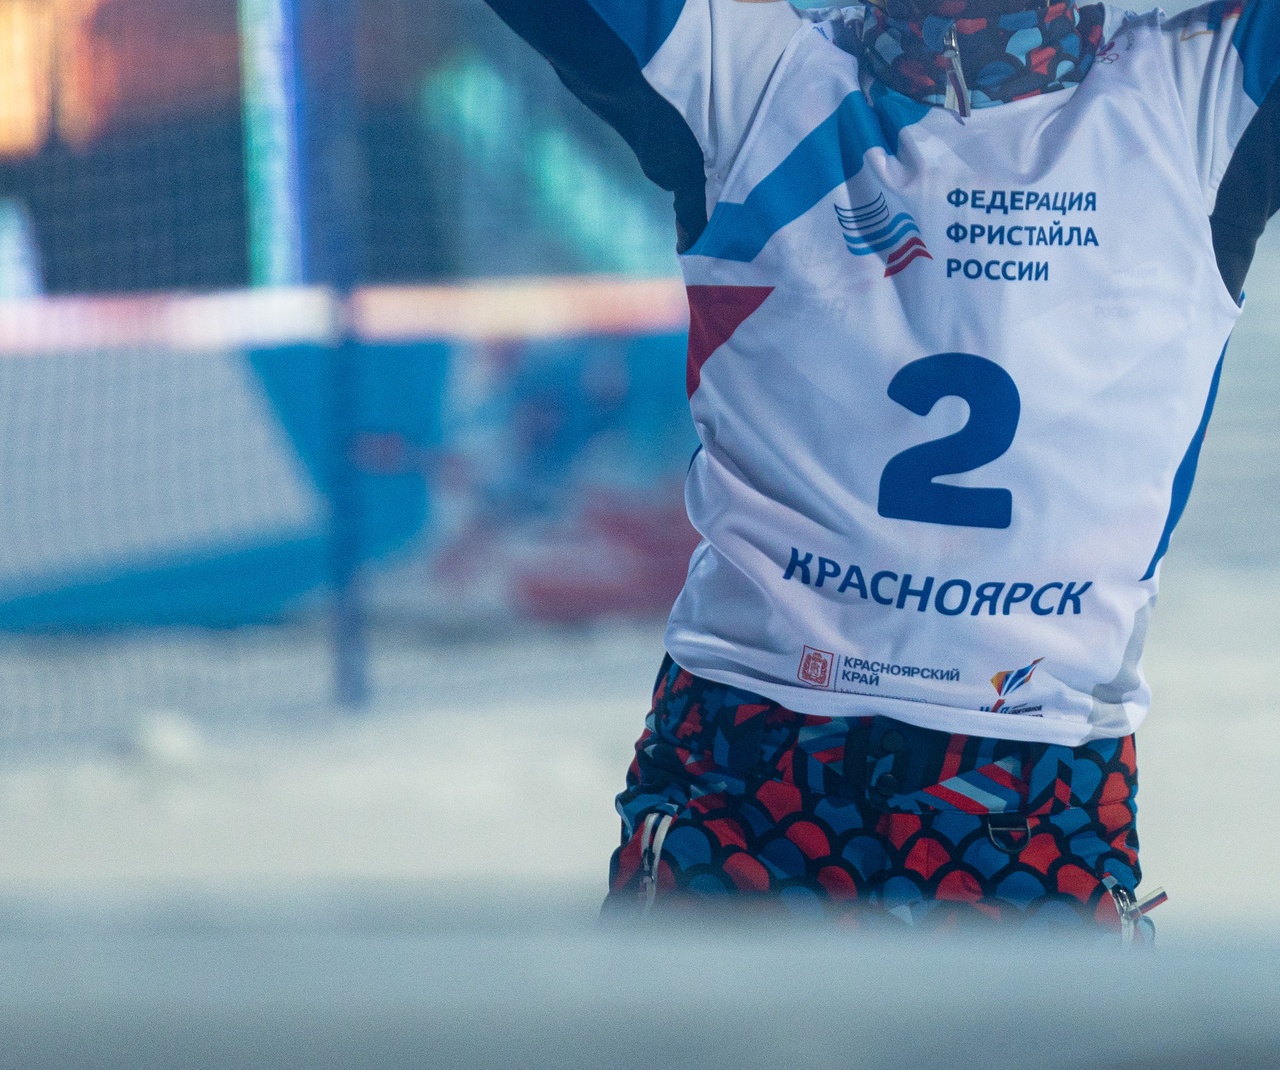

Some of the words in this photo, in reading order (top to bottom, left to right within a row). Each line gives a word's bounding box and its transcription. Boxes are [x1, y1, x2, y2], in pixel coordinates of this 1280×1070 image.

[946, 188, 1097, 215] ФЕДЕРАЦИЯ
[946, 220, 1099, 246] ФРИСТАЙЛА
[946, 258, 1049, 281] РОССИИ
[877, 352, 1021, 529] 2
[782, 547, 1093, 616] КРАСНОЯРСК
[841, 669, 880, 686] КРАЙ
[843, 656, 960, 682] КРАСНОЯРСКИЙ
